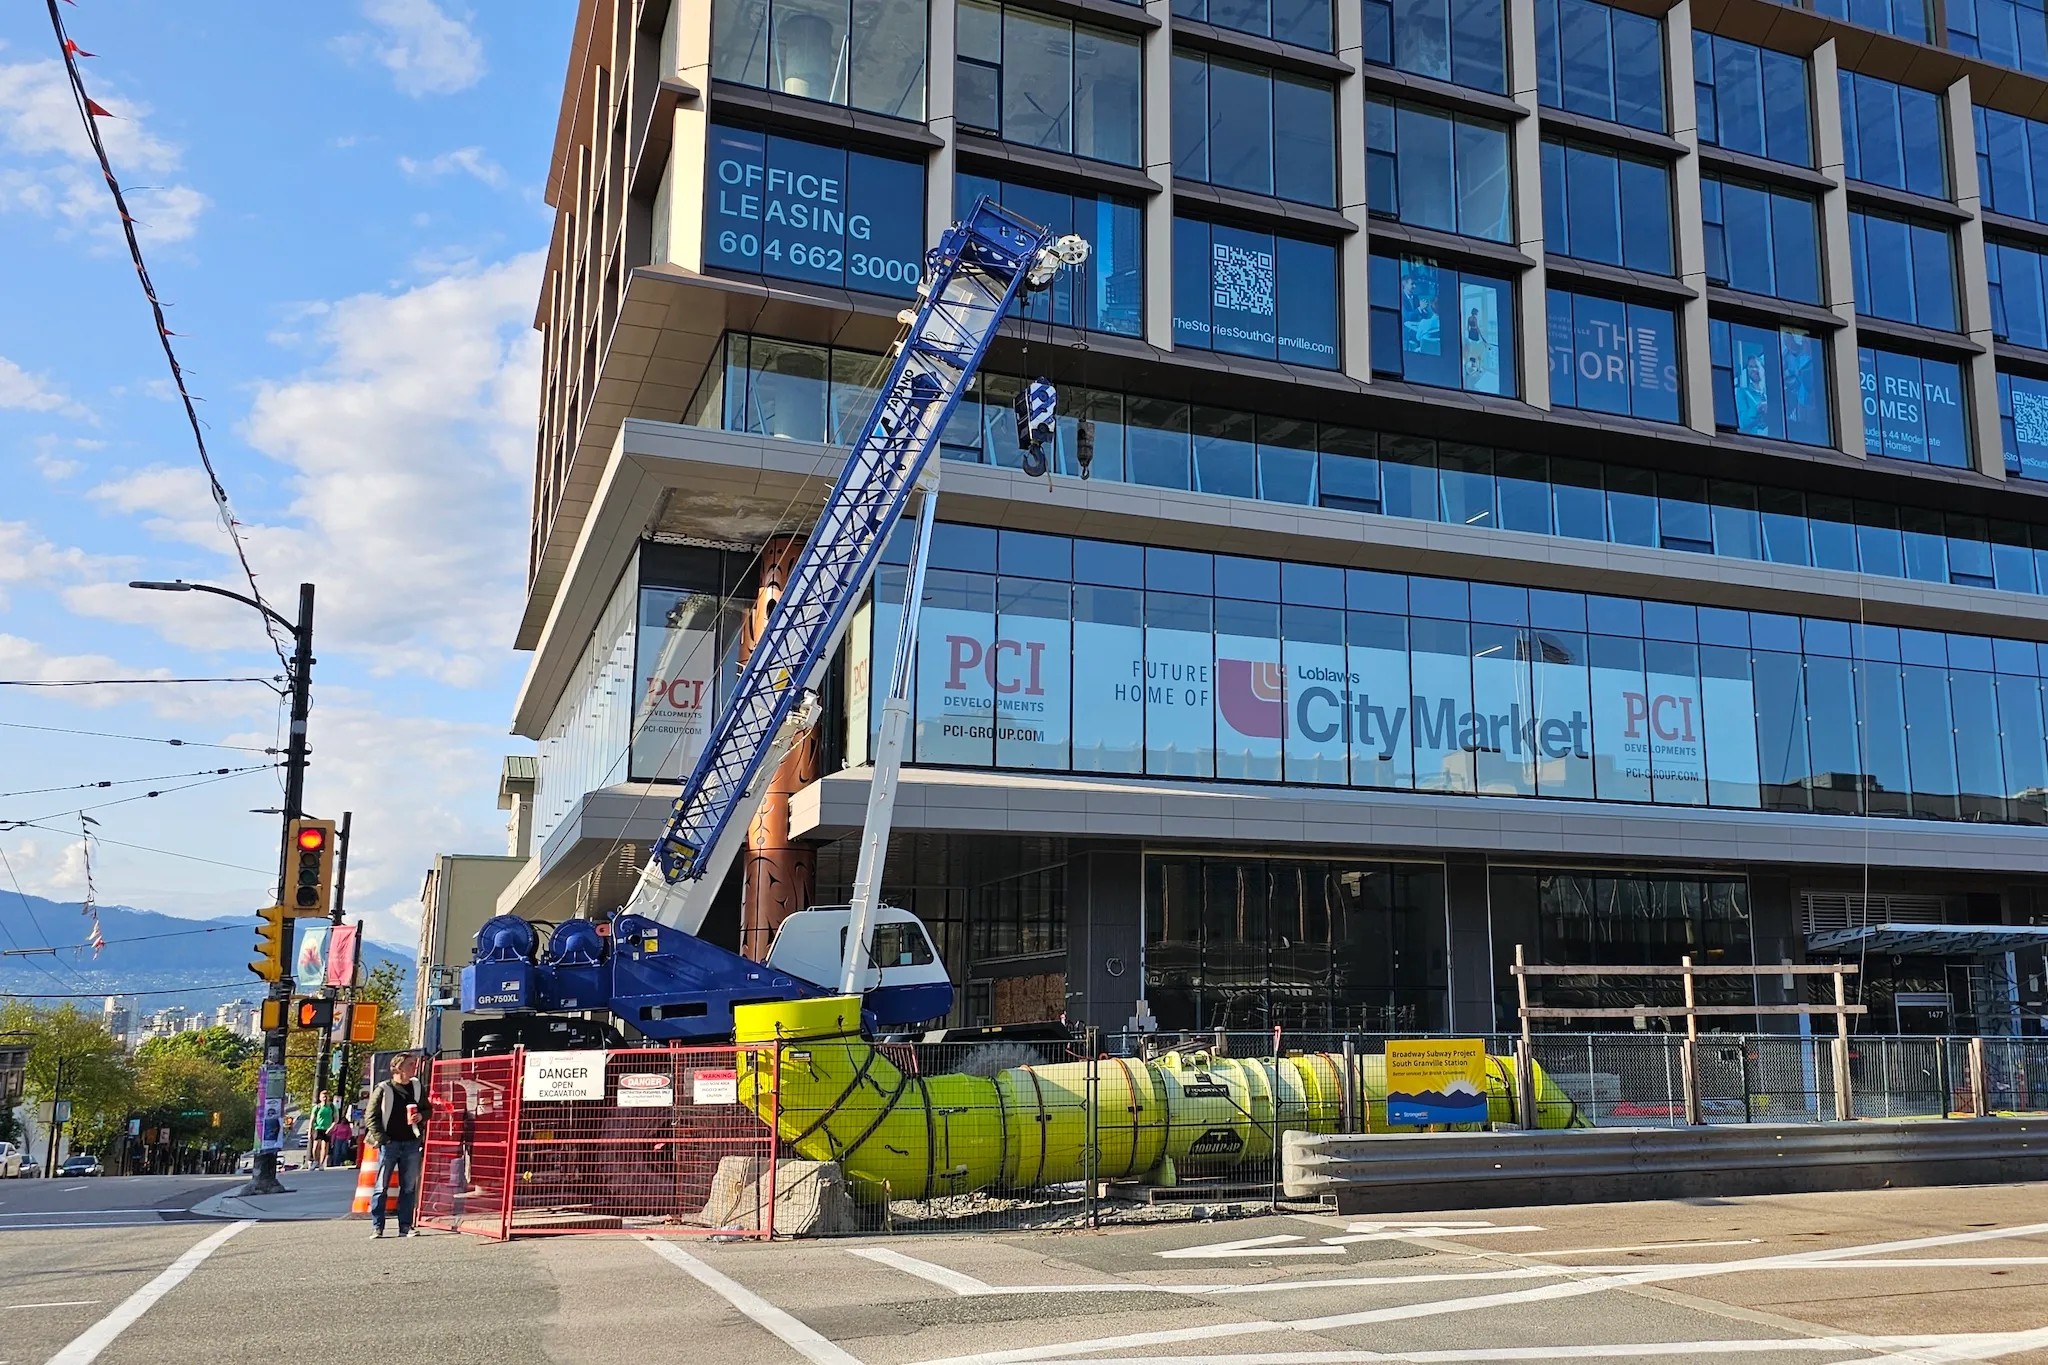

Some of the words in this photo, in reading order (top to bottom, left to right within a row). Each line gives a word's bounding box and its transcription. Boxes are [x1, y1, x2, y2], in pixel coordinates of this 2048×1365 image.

[718, 159, 839, 204] OFFICE
[719, 190, 872, 241] LEASING
[719, 230, 782, 261] 604
[789, 242, 842, 273] 662
[851, 253, 920, 286] 3000
[1884, 376, 1956, 406] RENTAL
[1885, 439, 1912, 453] Homes
[944, 634, 1046, 696] PCI
[1132, 660, 1208, 682] FUTURE
[1298, 665, 1360, 684] Loblaws
[645, 677, 704, 709] PCI
[1115, 683, 1174, 705] HOME
[1185, 689, 1208, 706] OF
[944, 695, 1044, 713] DEVELOPMENTS
[645, 709, 703, 719] DEVELOPMENTS
[1622, 691, 1696, 742] PCI
[943, 724, 1045, 742] PCI-GROUP.COM
[1624, 743, 1697, 757] DEVELOPMENTS
[1625, 767, 1699, 782] PCI-GROUP.COM
[1928, 1010, 1944, 1019] 1477
[1392, 1050, 1425, 1059] Broadway
[1426, 1050, 1452, 1058] Subway
[1453, 1050, 1476, 1058] Project
[539, 1067, 588, 1079] DANGER
[628, 1077, 662, 1087] DANGER
[539, 1089, 587, 1097] EXCAVATION
[551, 1081, 574, 1089] OPEN
